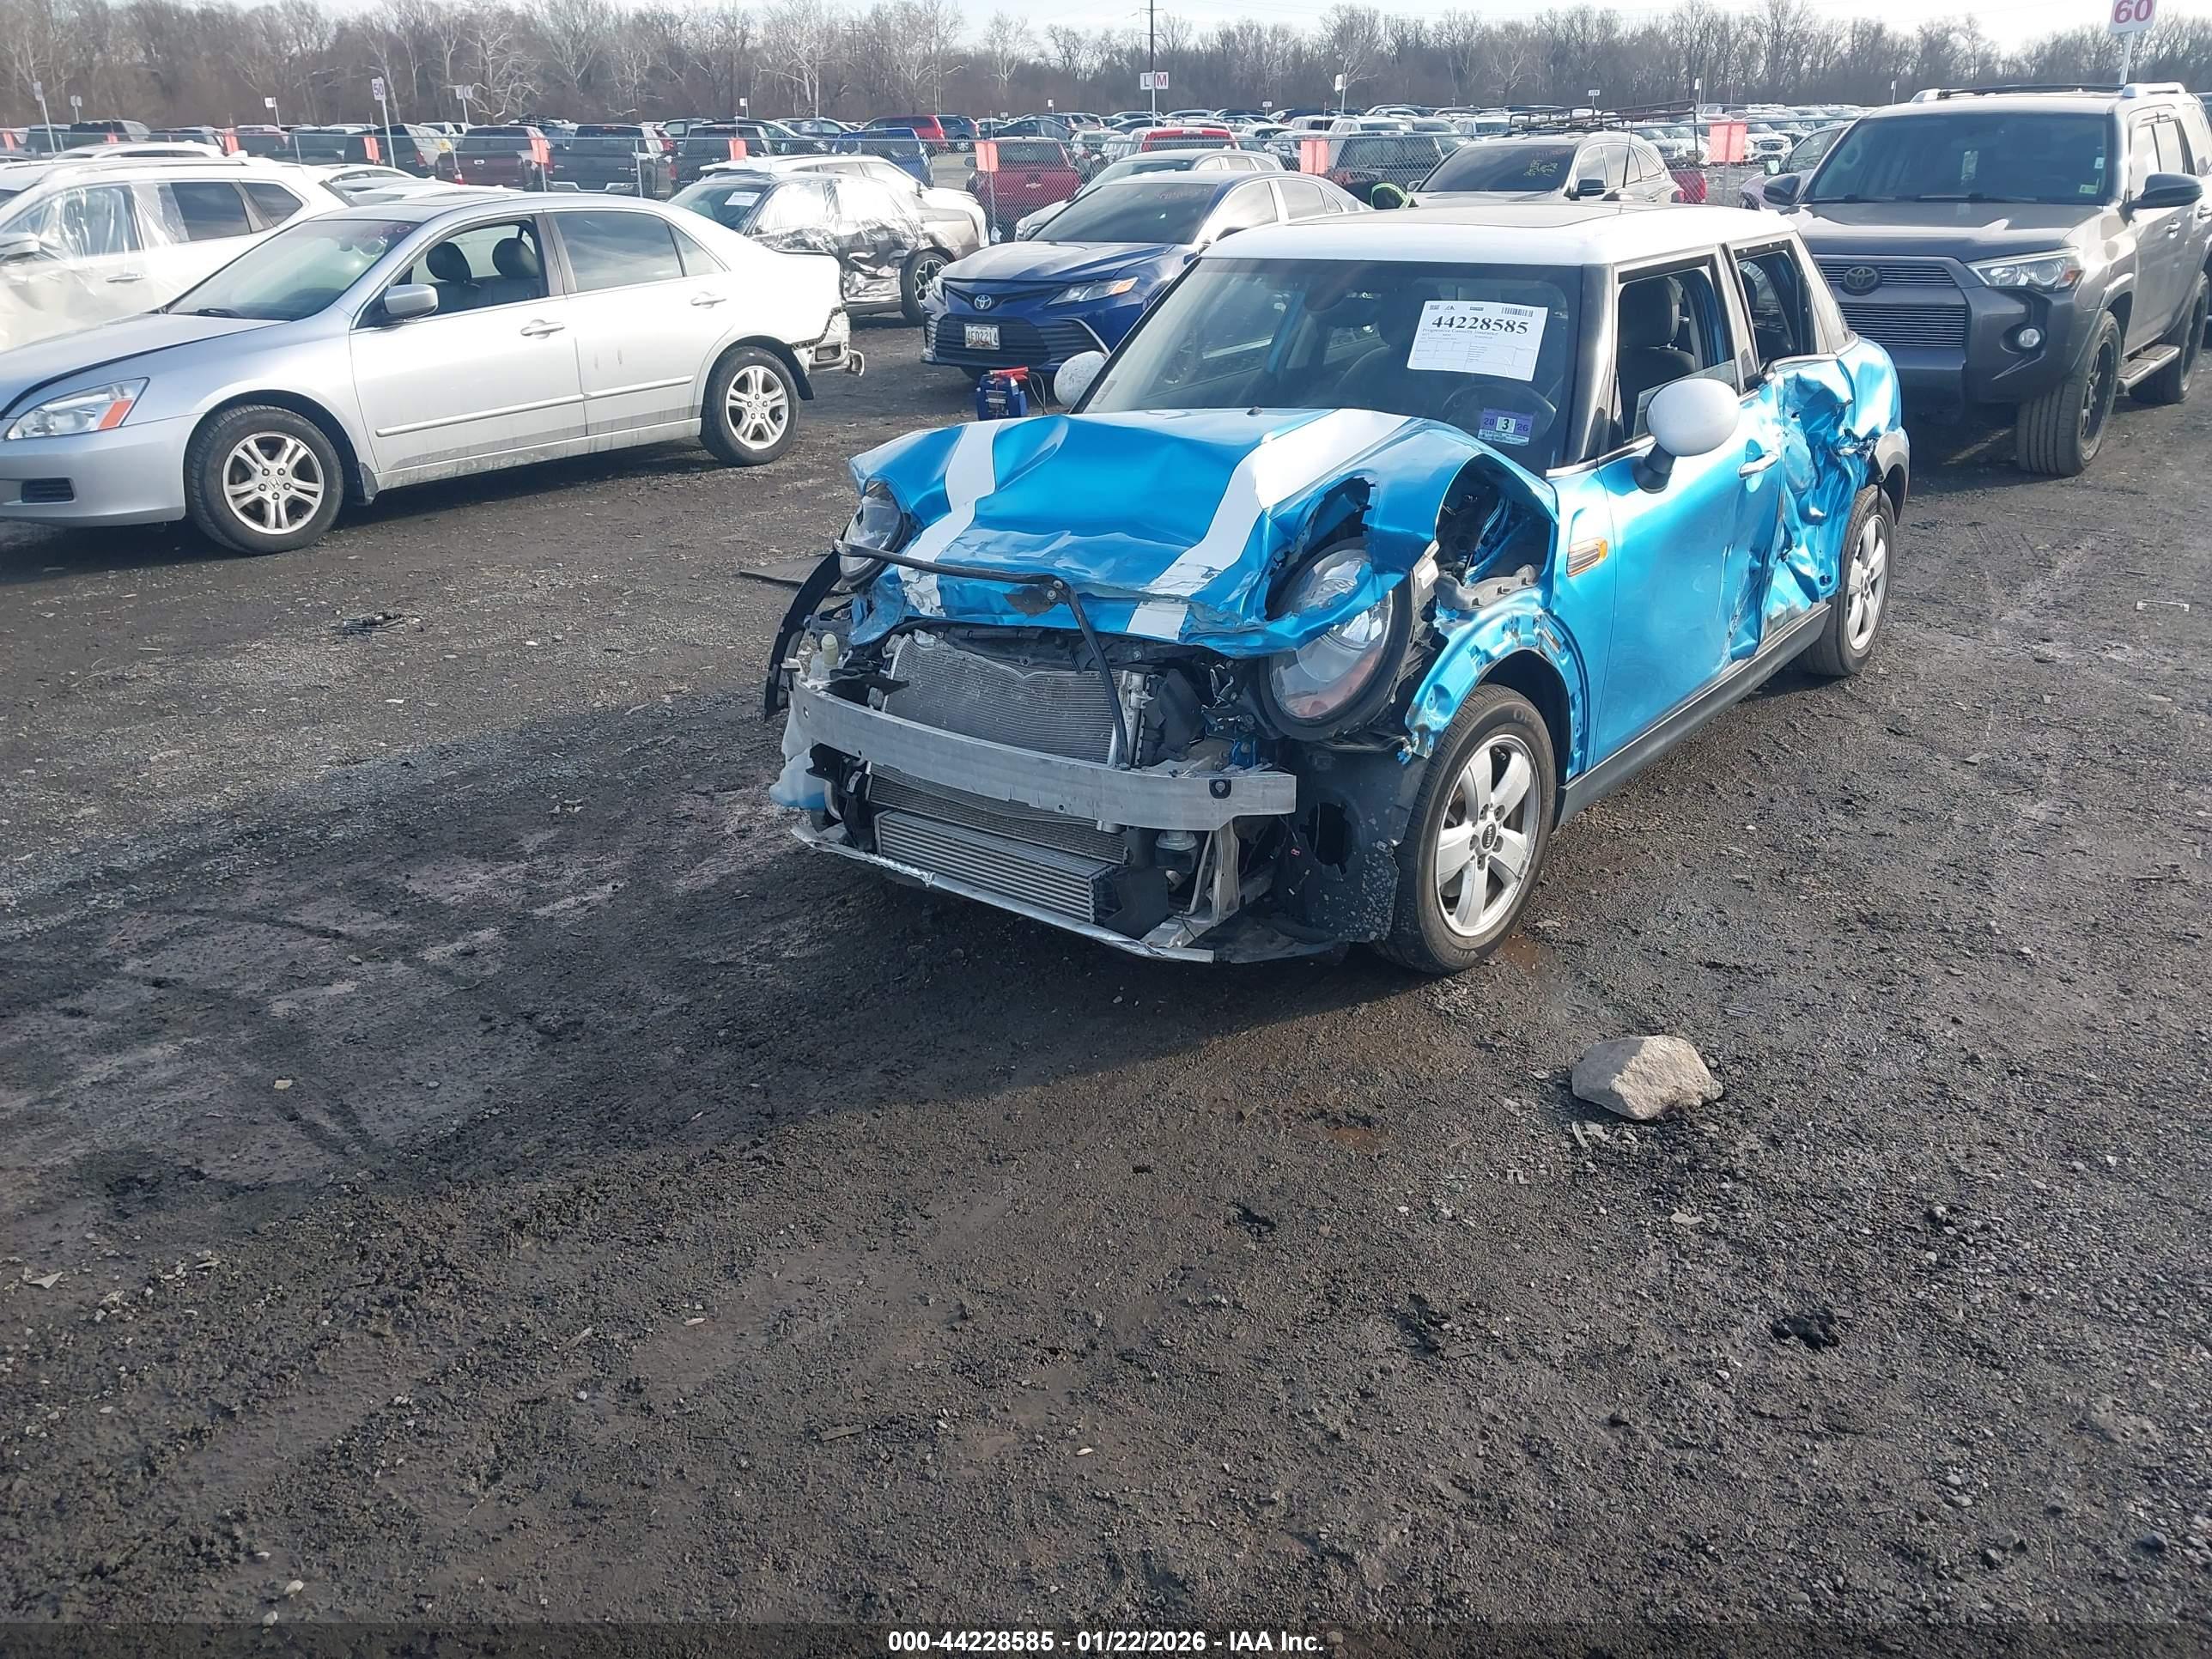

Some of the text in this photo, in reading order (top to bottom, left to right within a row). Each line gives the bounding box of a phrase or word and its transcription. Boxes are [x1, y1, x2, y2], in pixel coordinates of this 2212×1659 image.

[2114, 0, 2153, 24] 60
[1144, 75, 1151, 87] L
[1157, 75, 1167, 87] M
[373, 82, 385, 96] 50
[1431, 315, 1529, 335] 44228585
[1483, 417, 1529, 432] 20 3 26
